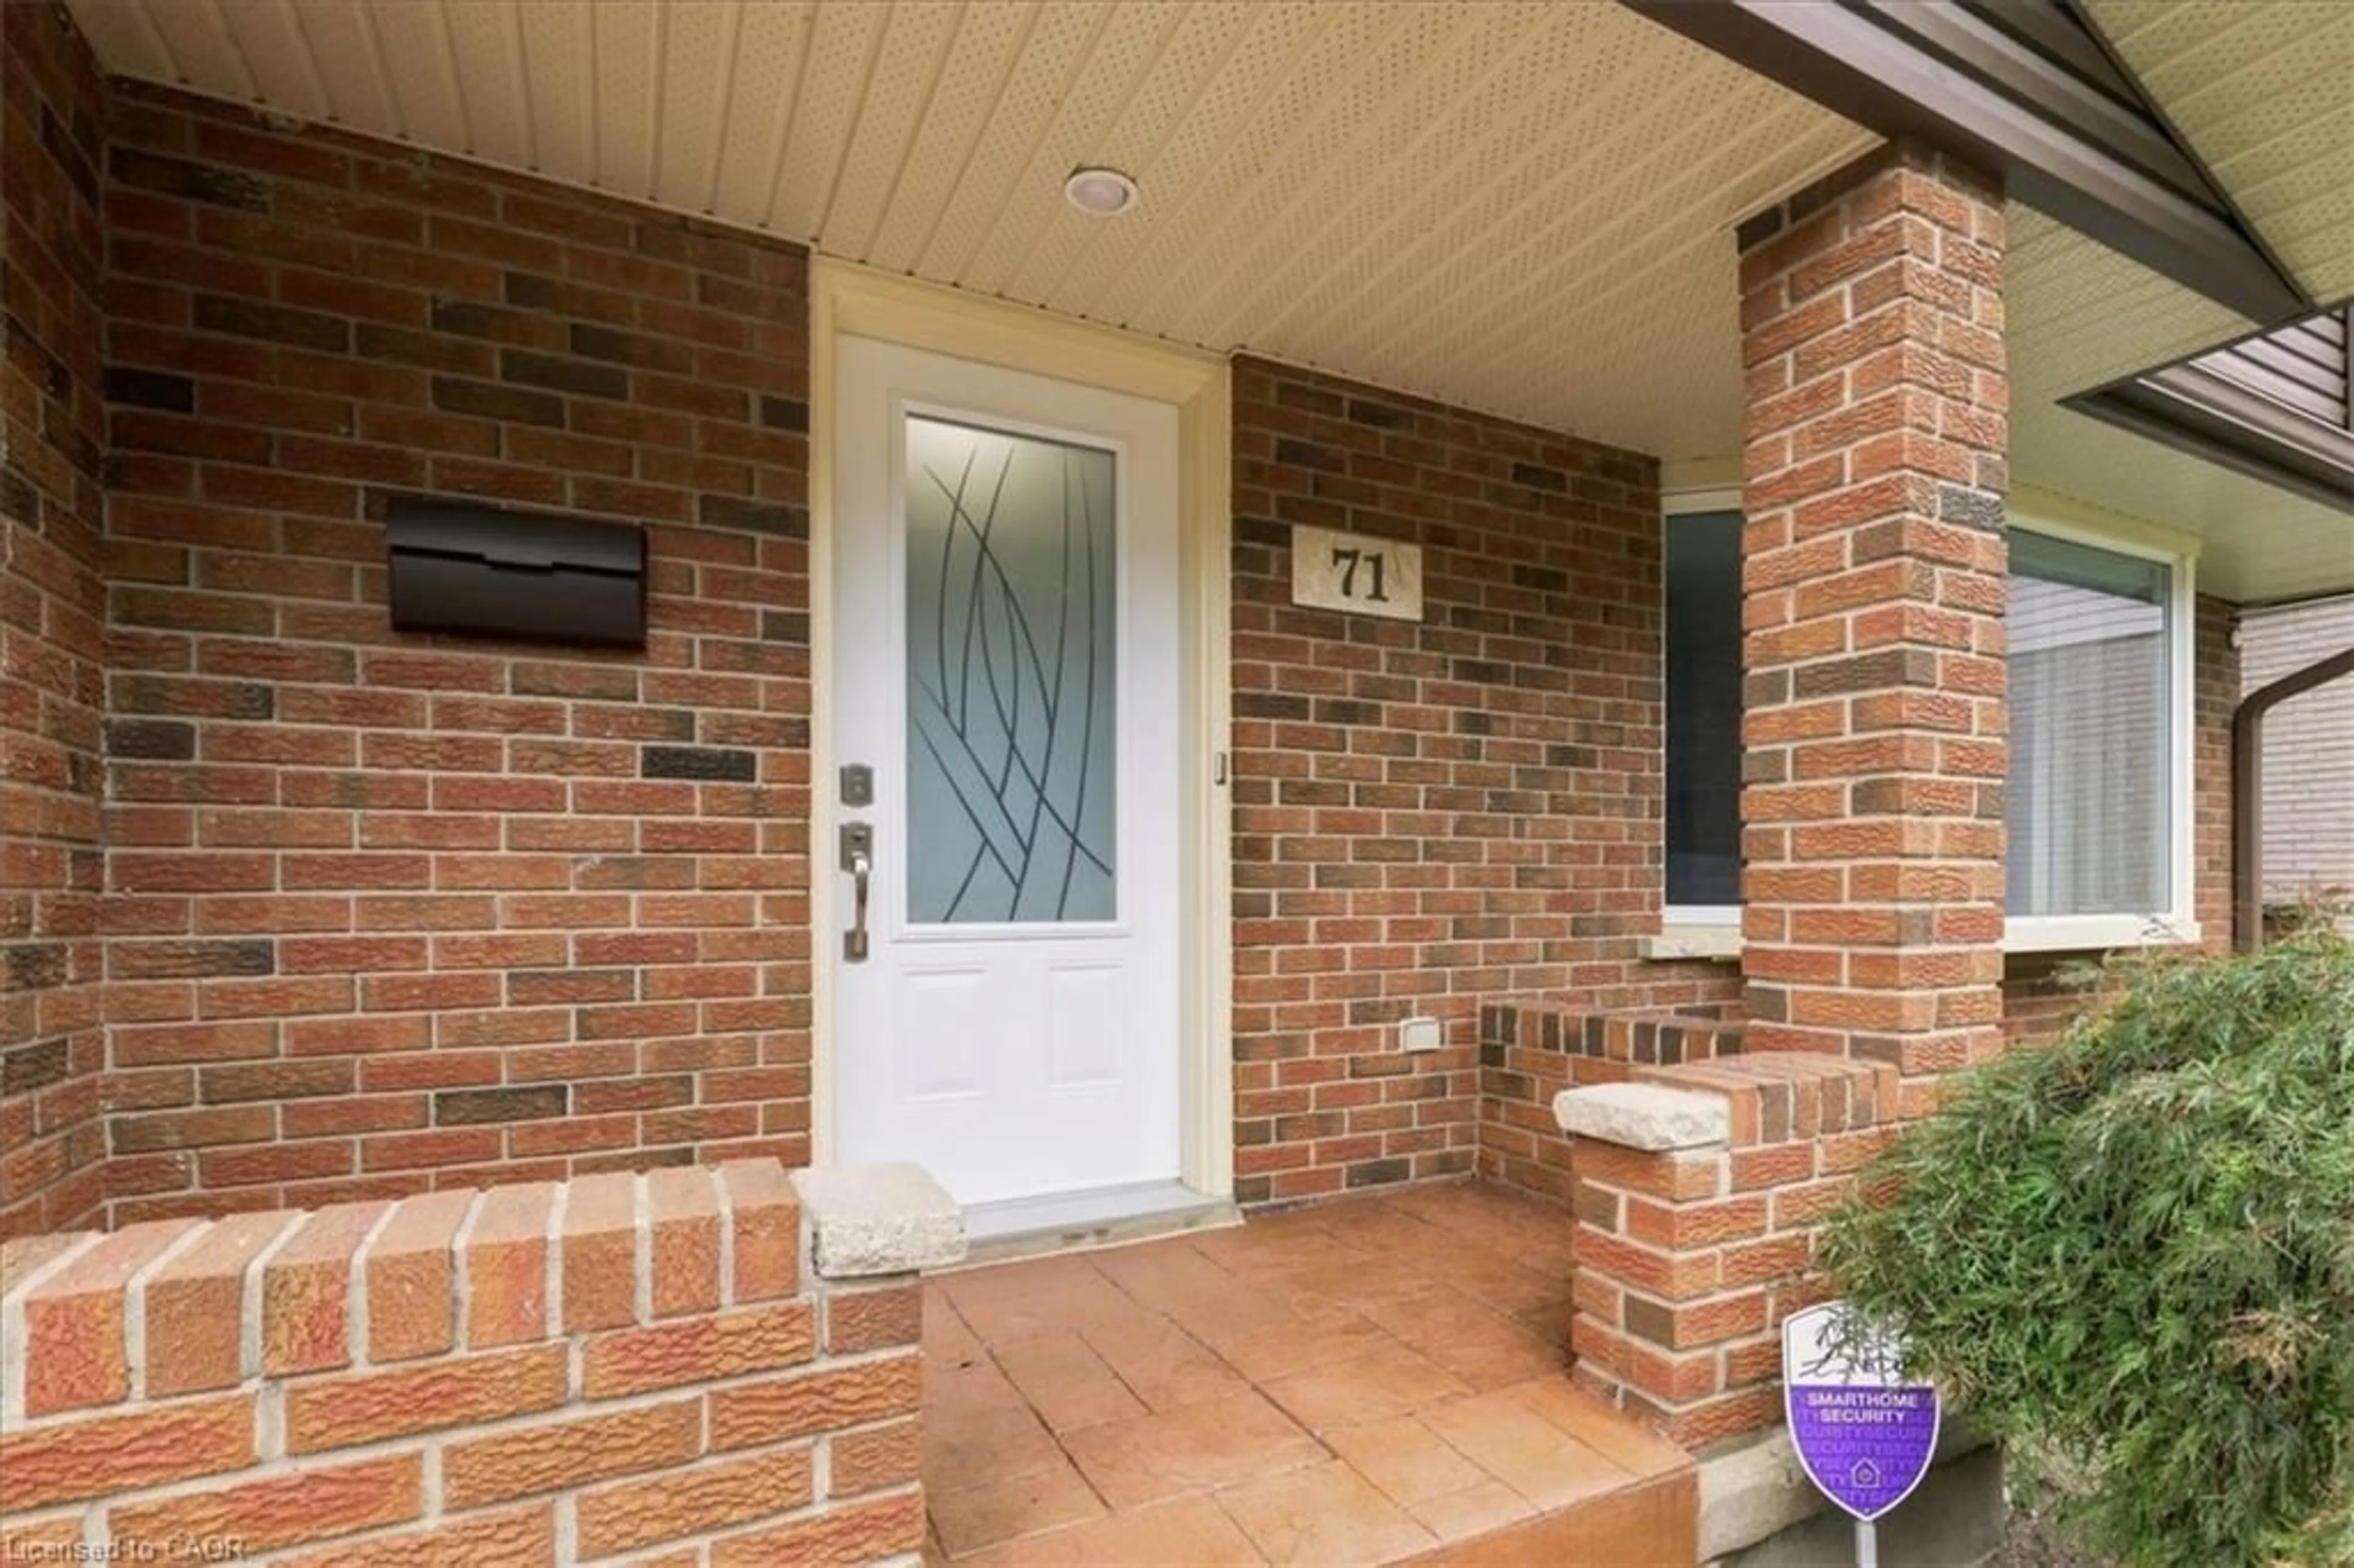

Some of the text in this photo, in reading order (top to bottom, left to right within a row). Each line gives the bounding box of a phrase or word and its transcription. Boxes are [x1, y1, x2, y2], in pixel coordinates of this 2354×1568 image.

[1331, 549, 1390, 603] 71
[1806, 1391, 1918, 1408] SMARTHOME
[1820, 1408, 1906, 1423] SECURITY
